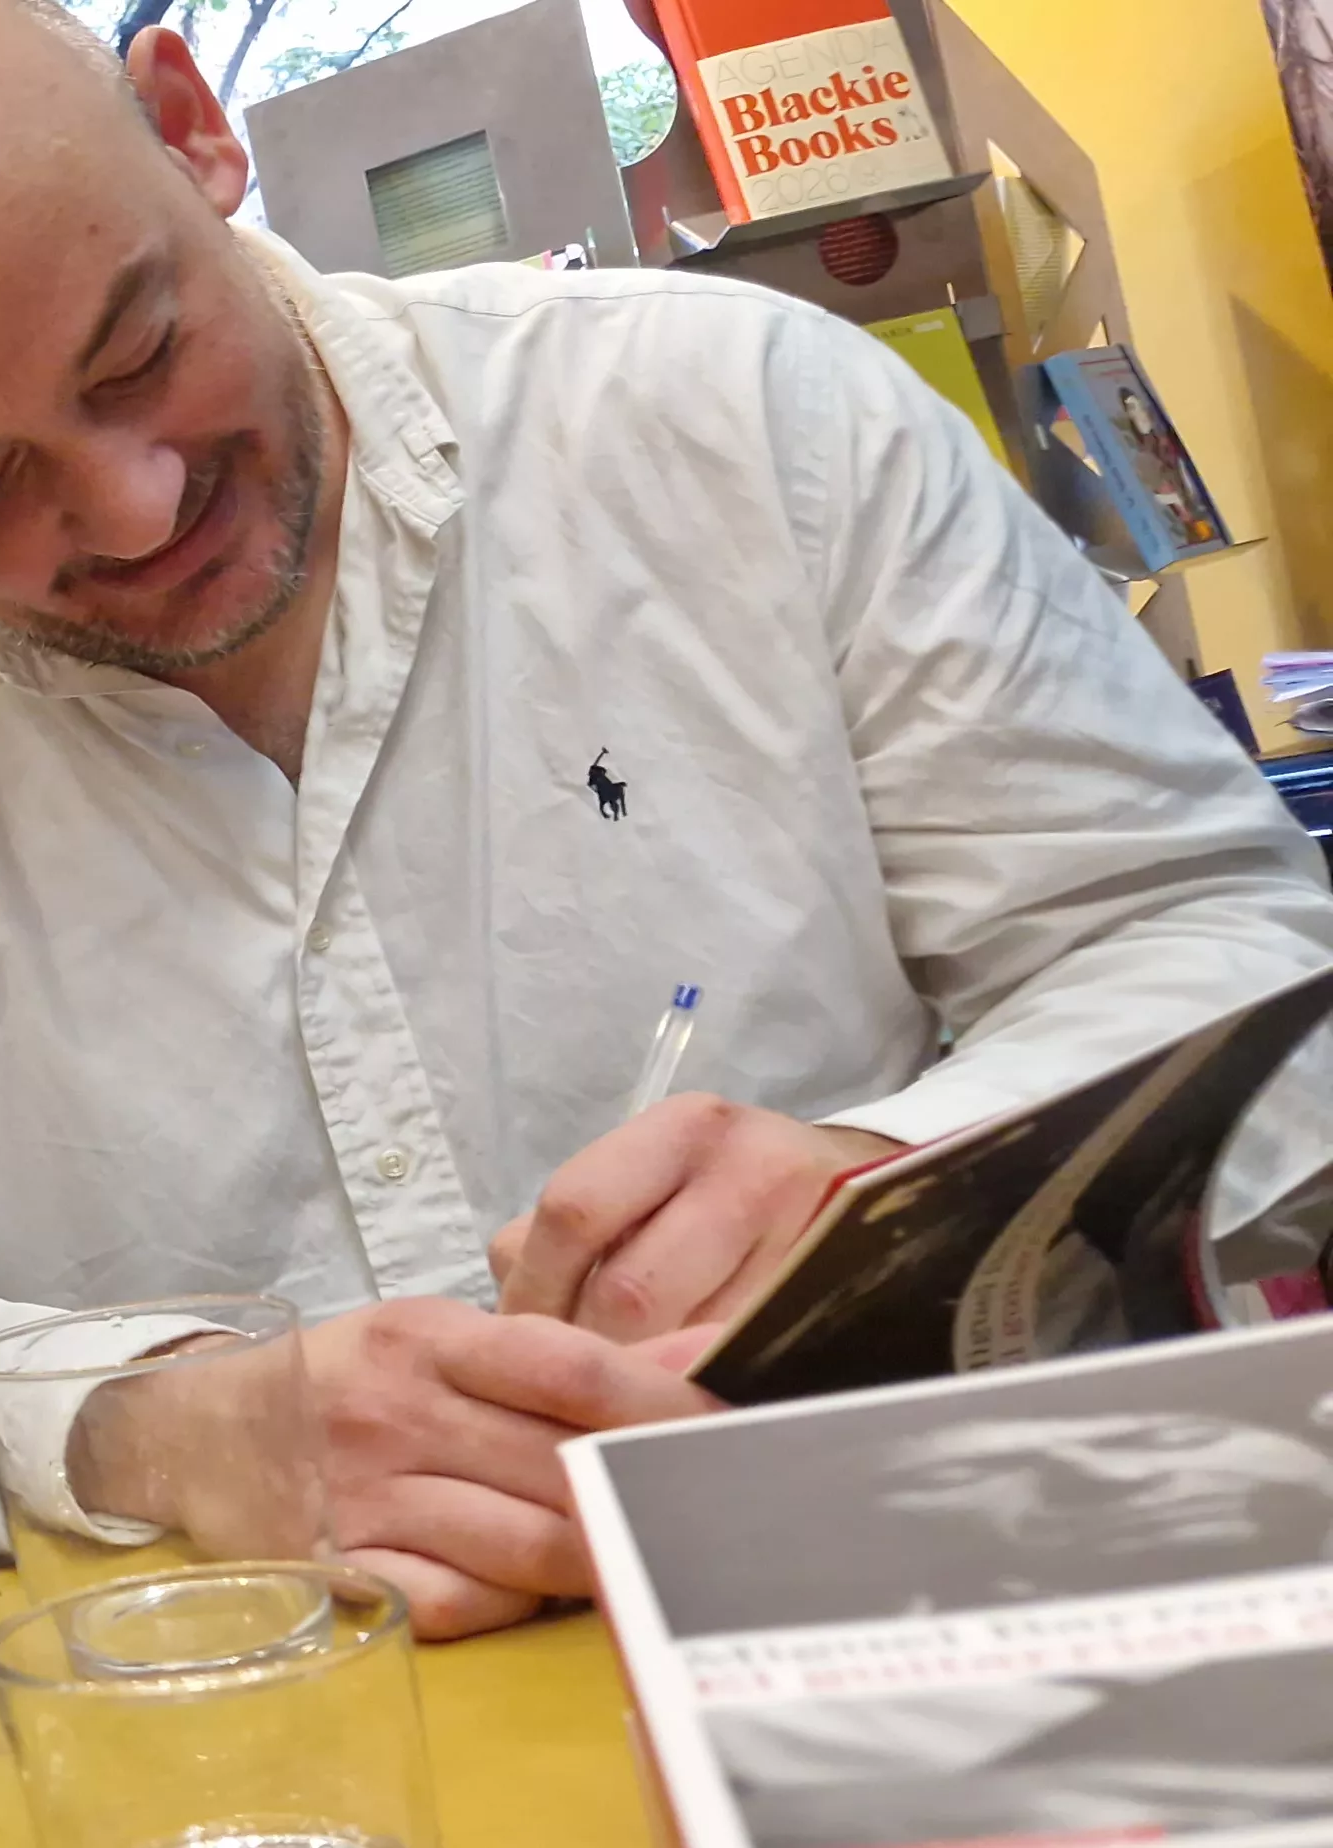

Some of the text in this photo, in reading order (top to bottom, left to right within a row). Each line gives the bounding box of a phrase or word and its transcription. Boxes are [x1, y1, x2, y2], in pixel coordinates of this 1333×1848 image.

[716, 25, 905, 92] AGENDA
[719, 65, 911, 137] Blackie
[734, 114, 899, 178] Books
[752, 162, 851, 213] 2026
